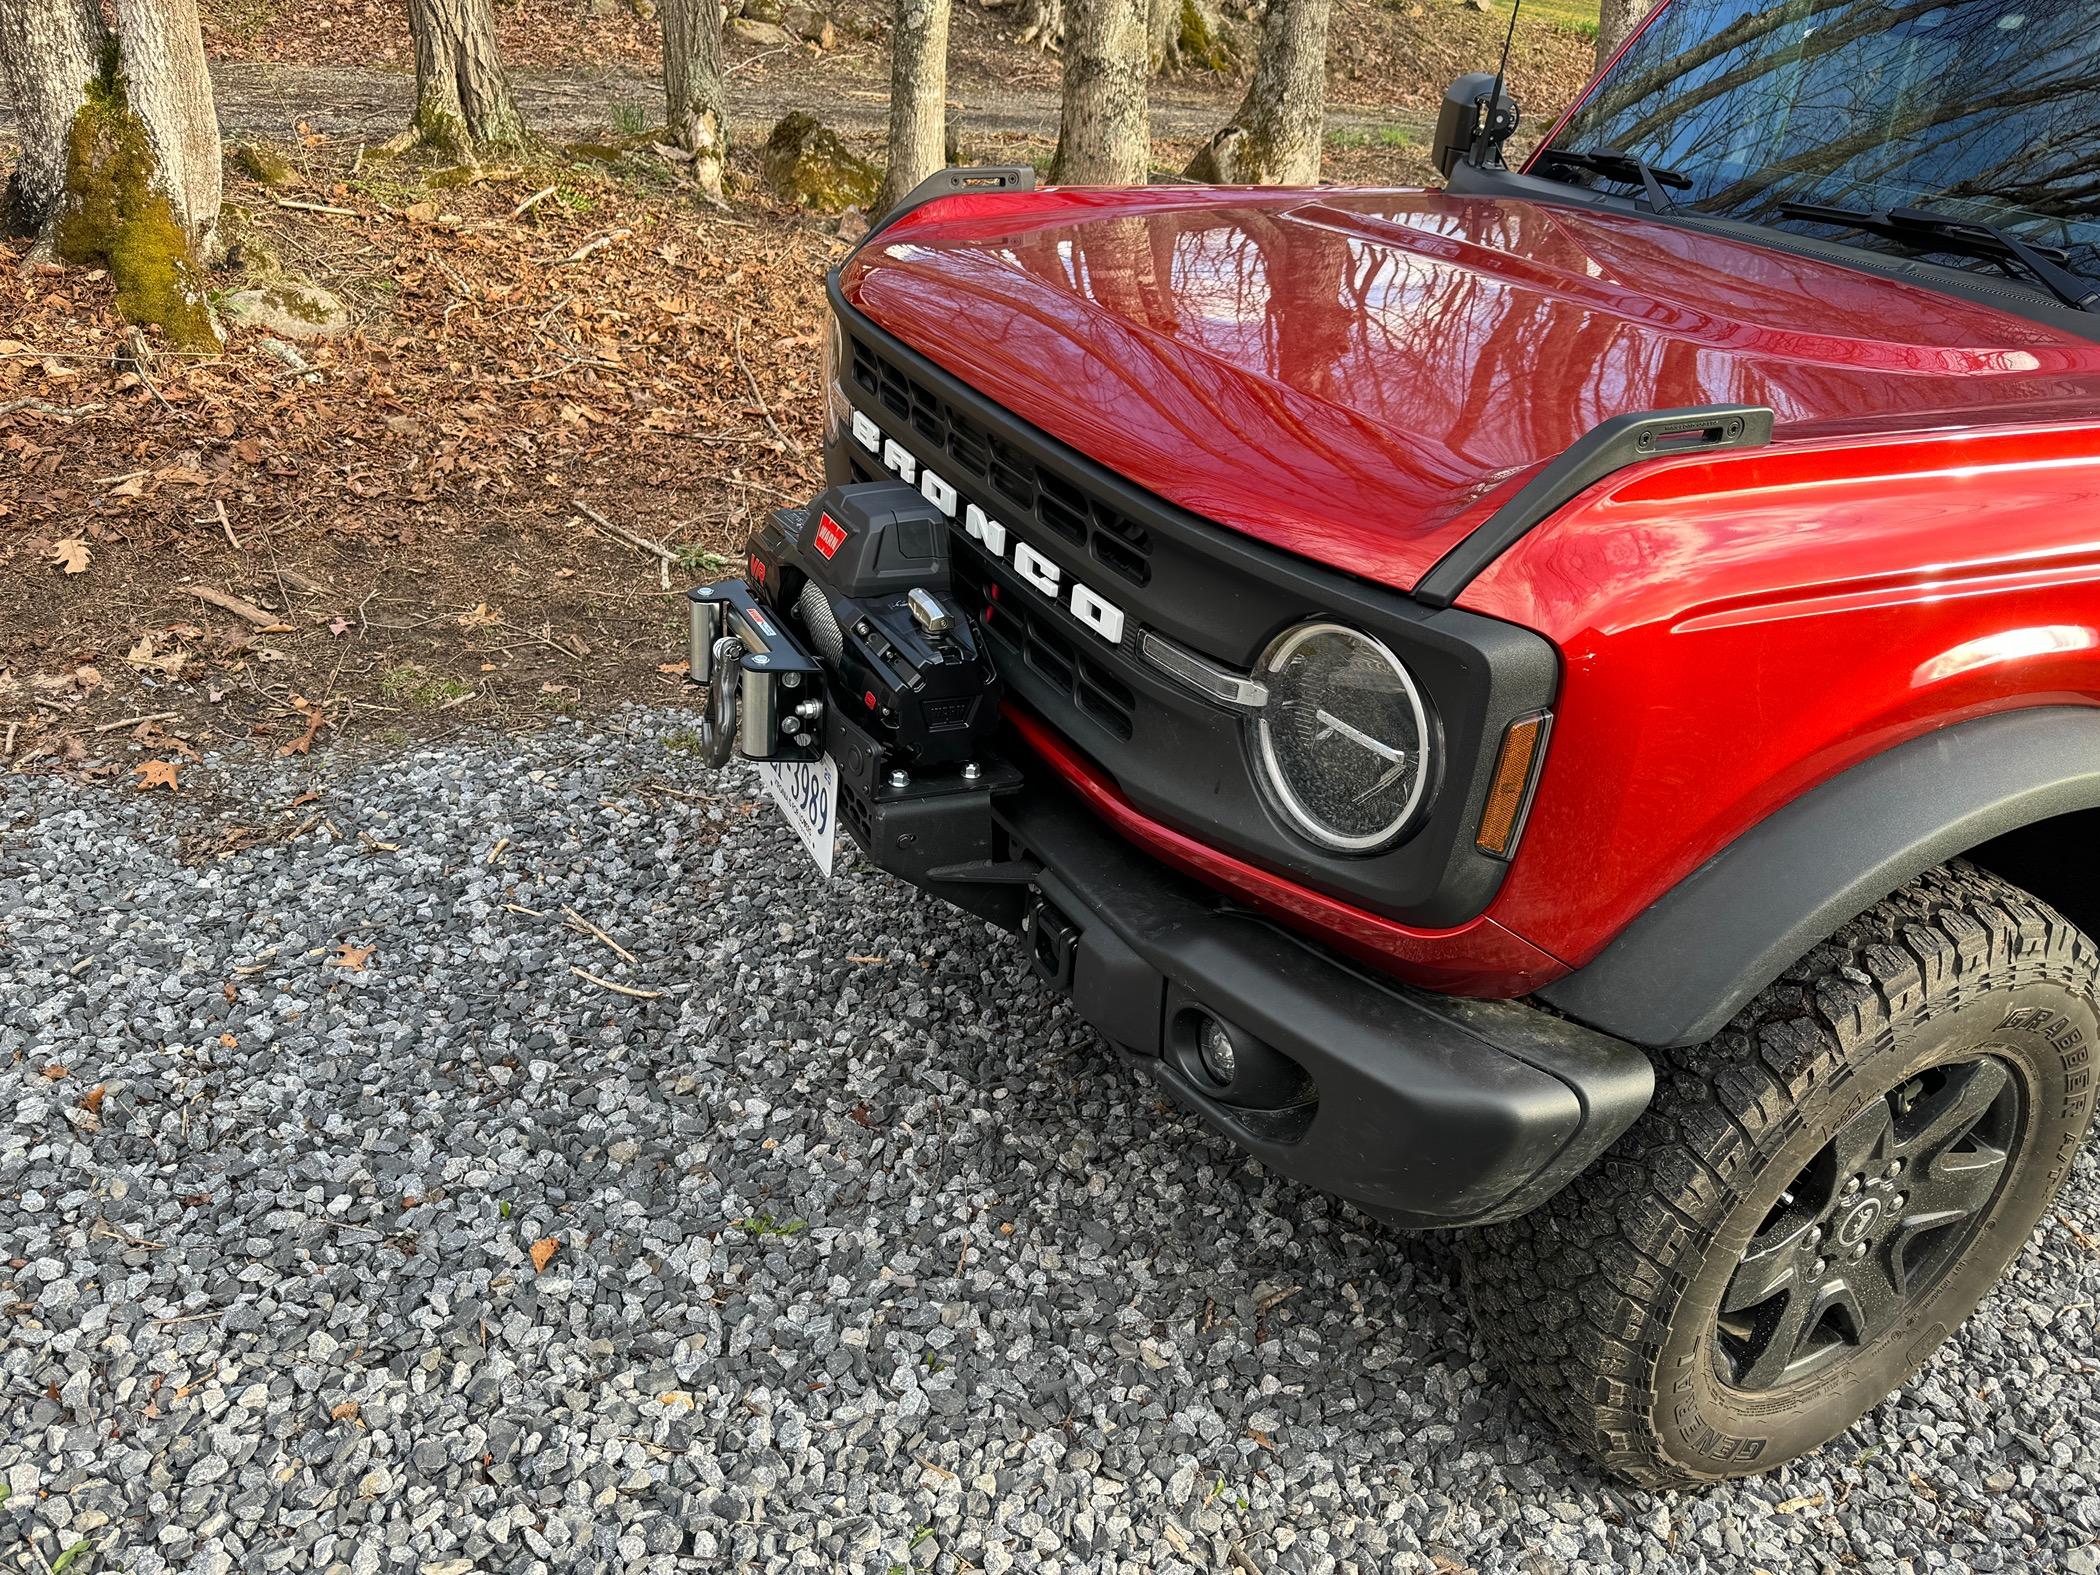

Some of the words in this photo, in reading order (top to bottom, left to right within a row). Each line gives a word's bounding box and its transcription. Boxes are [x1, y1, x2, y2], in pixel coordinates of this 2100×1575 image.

[819, 525, 838, 550] WARN
[852, 410, 1125, 644] BRONCO
[1992, 1007, 2089, 1119] GRABBER
[1674, 1335, 1767, 1463] GENERAL
